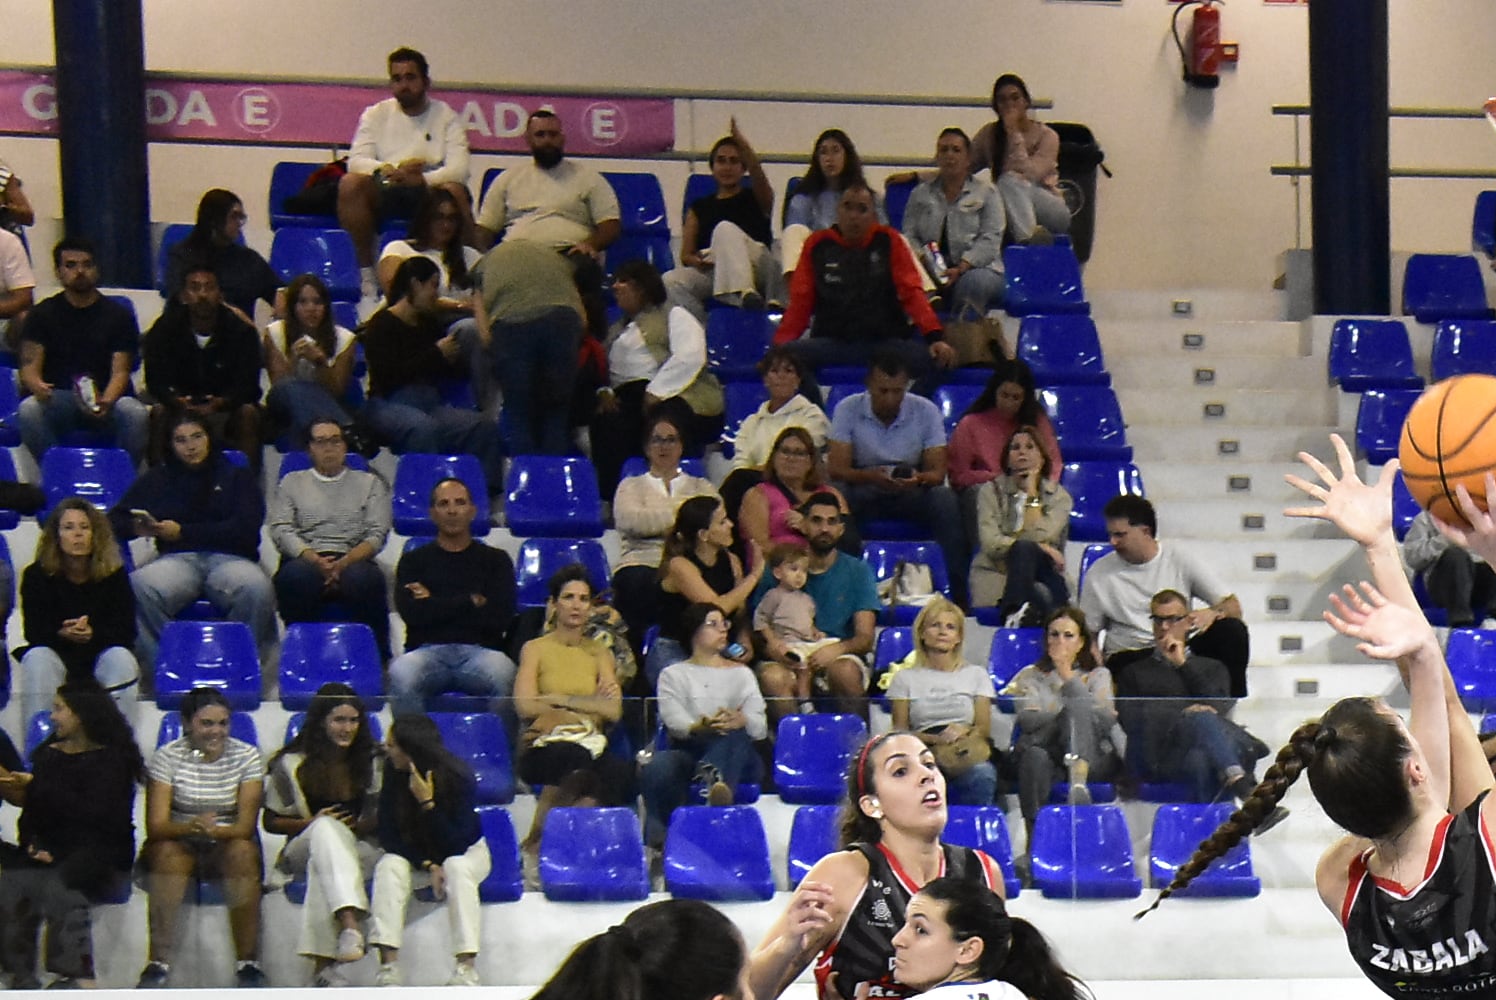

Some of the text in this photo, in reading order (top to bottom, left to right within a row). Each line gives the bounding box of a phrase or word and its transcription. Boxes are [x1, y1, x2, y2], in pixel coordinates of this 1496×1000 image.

[22, 84, 269, 126] GDA E
[592, 109, 616, 139] E
[1370, 929, 1488, 973] ZABALA
